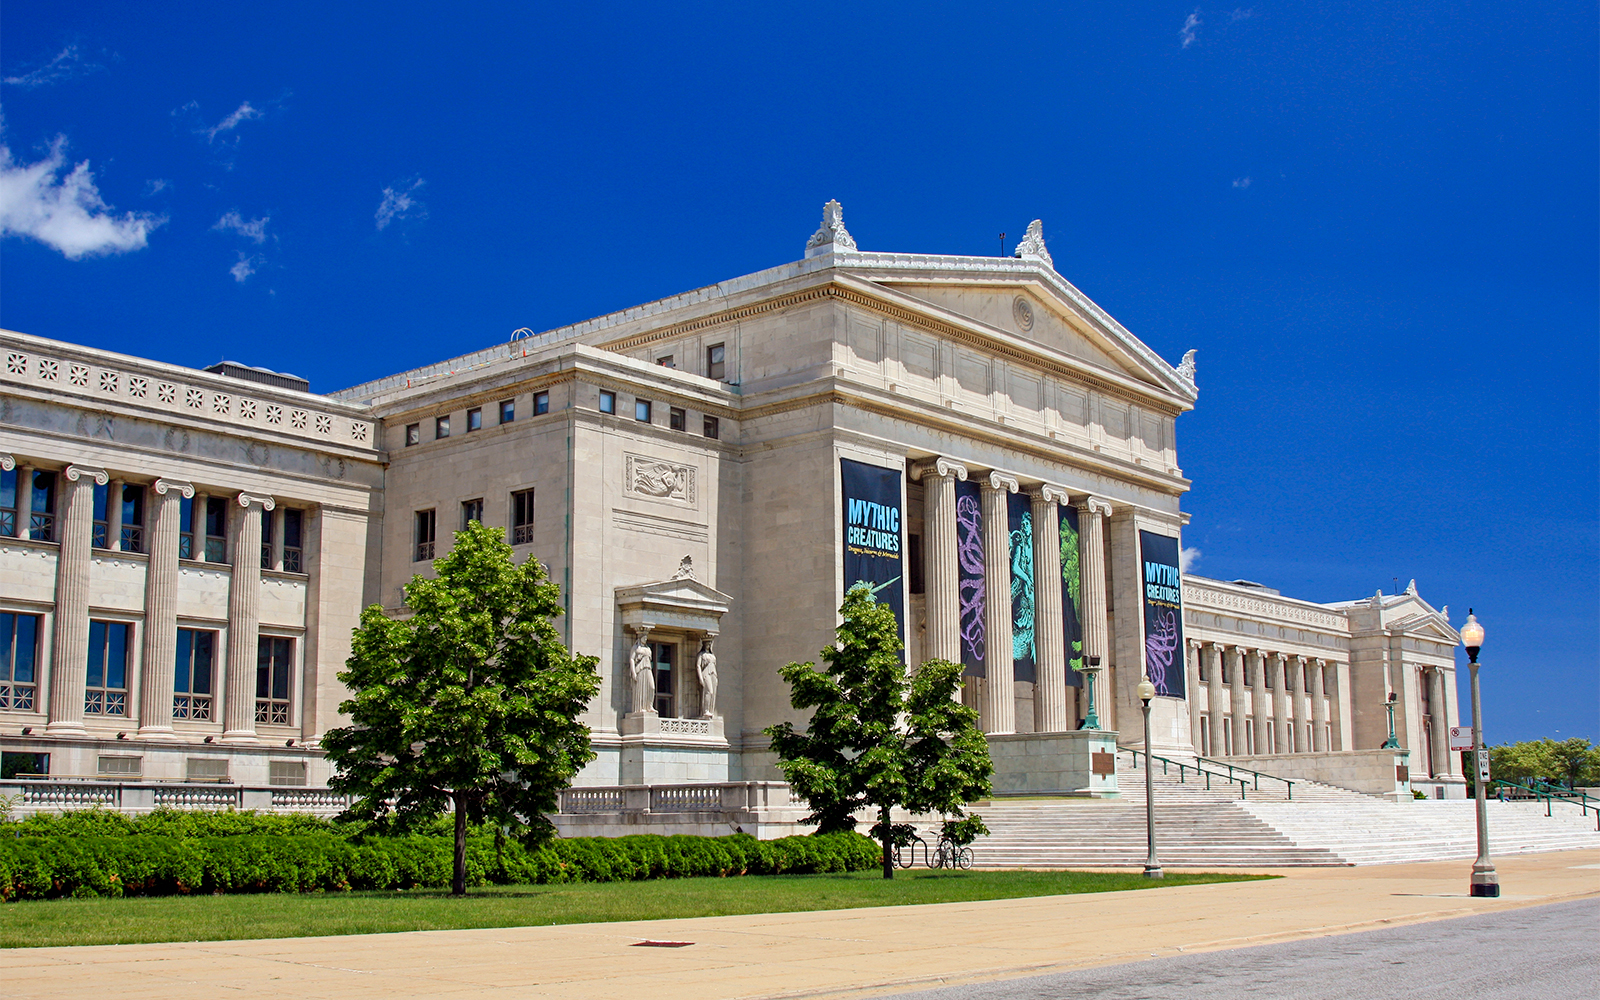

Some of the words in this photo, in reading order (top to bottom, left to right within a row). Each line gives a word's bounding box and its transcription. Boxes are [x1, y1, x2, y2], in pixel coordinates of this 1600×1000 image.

[849, 498, 899, 533] MYTHIC
[848, 526, 899, 552] CREATURES
[1145, 561, 1179, 588] MYTHIC
[1146, 584, 1180, 604] CREATURES
[1480, 751, 1488, 760] ONE
